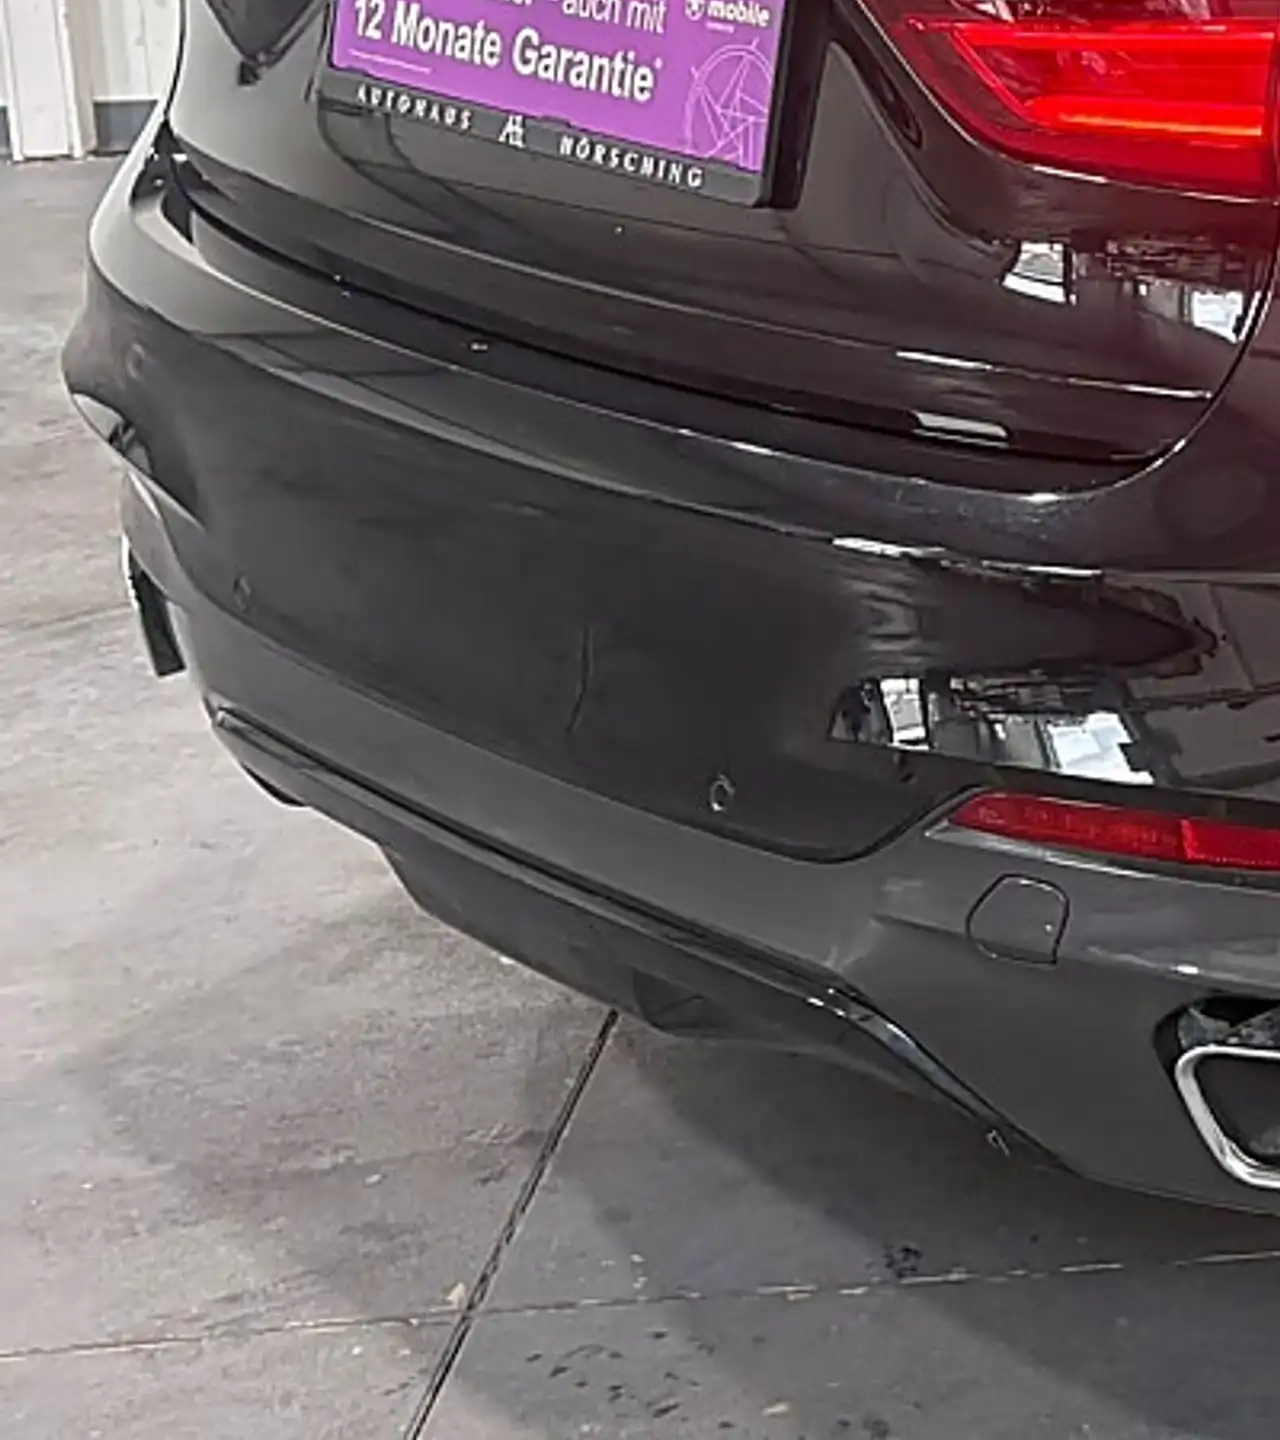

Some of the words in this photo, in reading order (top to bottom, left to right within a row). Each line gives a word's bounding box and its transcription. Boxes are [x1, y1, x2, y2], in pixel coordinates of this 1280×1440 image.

[391, 0, 501, 68] Monate
[707, 0, 770, 28] mobile
[357, 84, 472, 131] AUTOHAUS
[559, 134, 703, 188] HÖRSCHING
